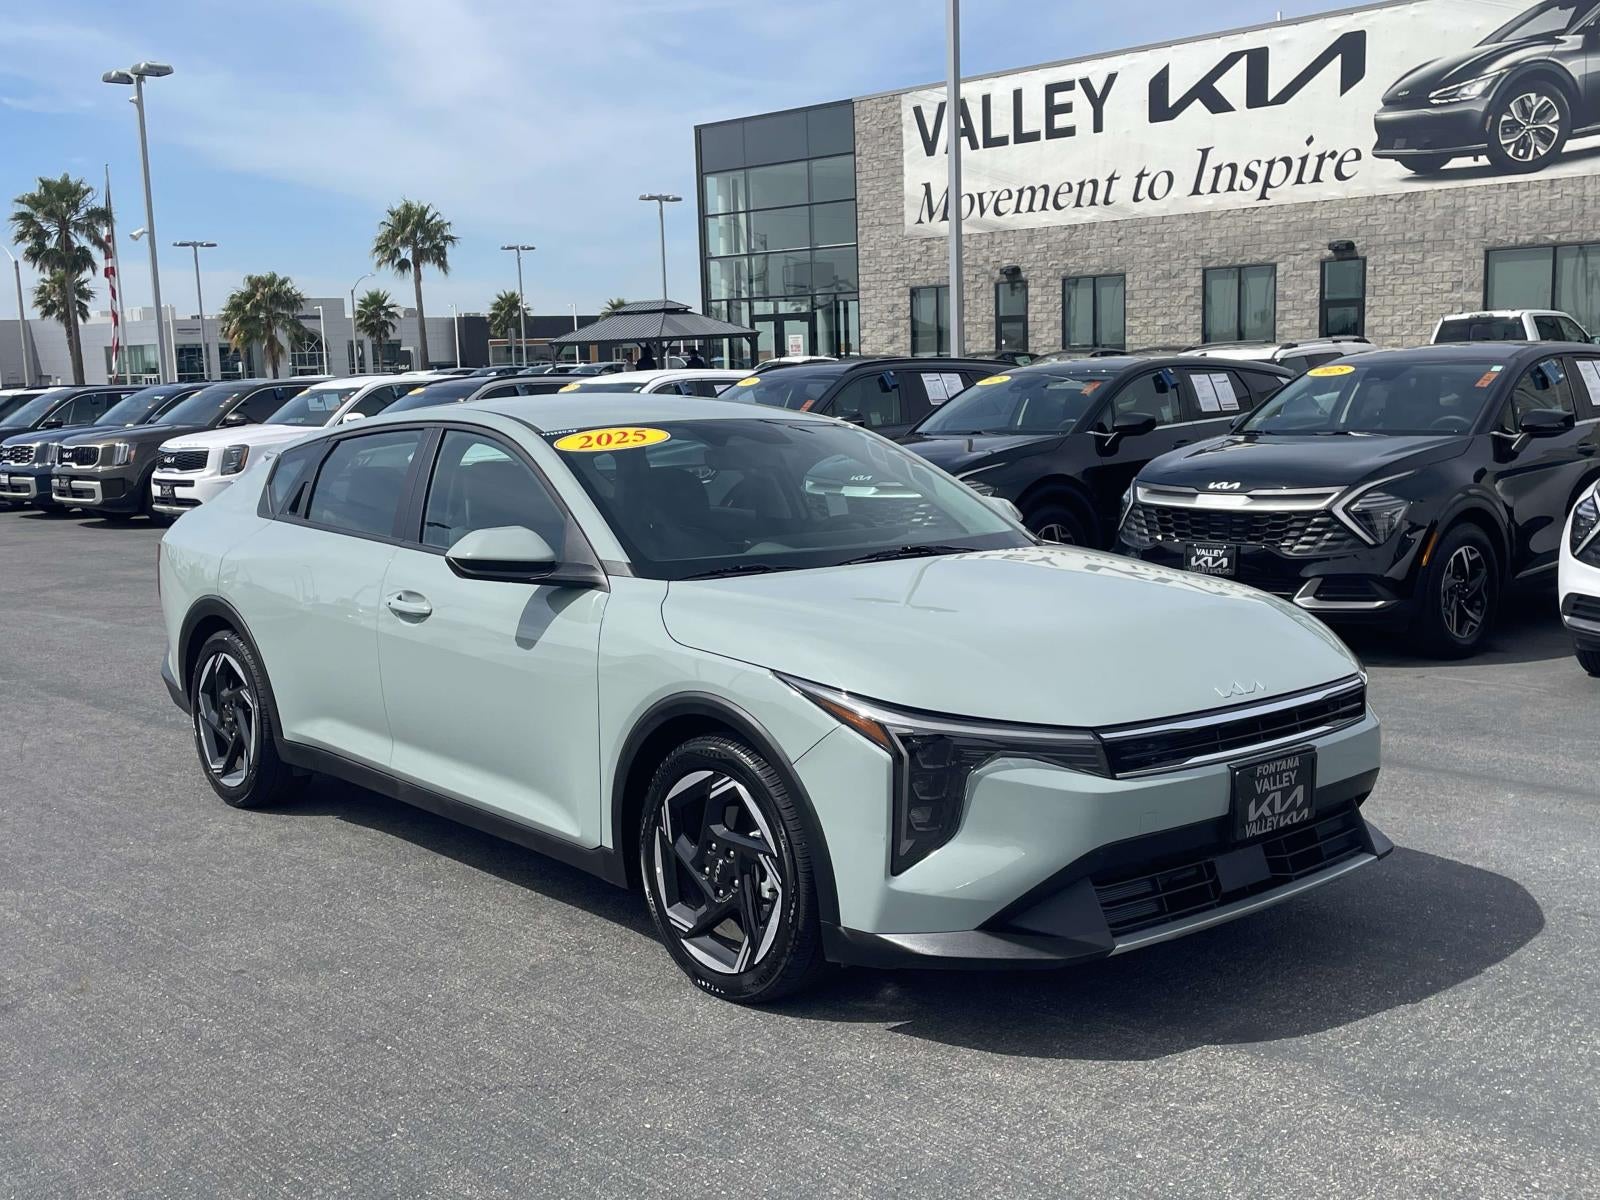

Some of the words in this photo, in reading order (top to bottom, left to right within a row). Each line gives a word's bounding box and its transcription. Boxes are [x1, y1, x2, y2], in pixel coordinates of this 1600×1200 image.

[913, 72, 1119, 157] VALLEY
[1149, 29, 1366, 123] KIA
[915, 169, 1121, 225] Movement
[1132, 166, 1175, 203] to
[1187, 135, 1362, 201] Inspire
[578, 429, 647, 449] 2025
[1190, 556, 1228, 568] KIA
[1195, 548, 1224, 557] VALLEY
[1214, 680, 1267, 698] KIA
[1256, 756, 1300, 778] FONTANA
[1255, 769, 1297, 795] VALLEY
[1248, 784, 1304, 822] KIA
[1245, 815, 1279, 838] VALLEY
[1280, 807, 1309, 828] KIA
